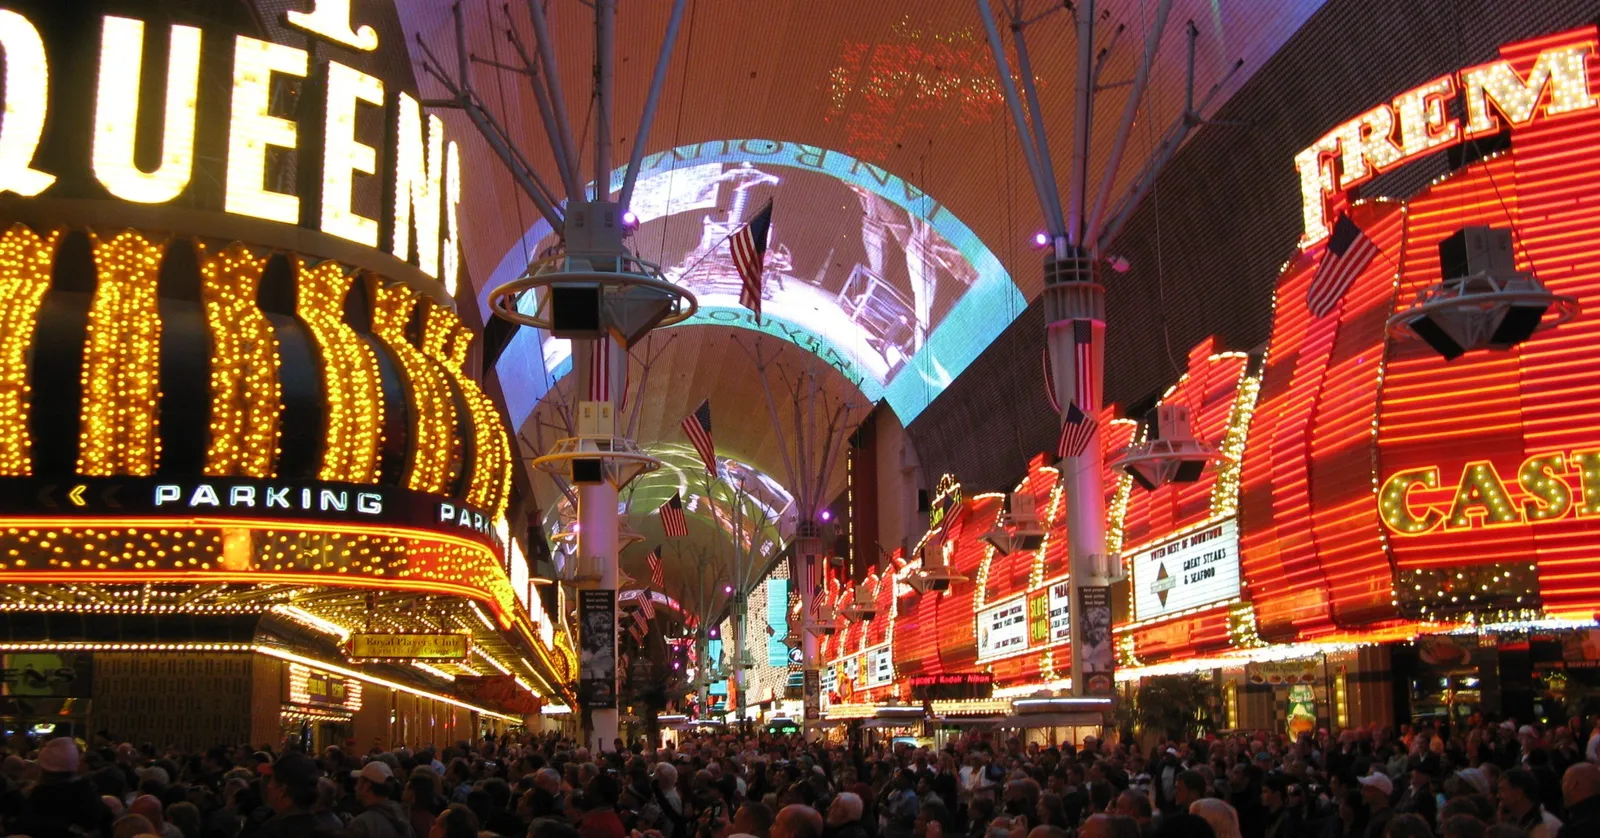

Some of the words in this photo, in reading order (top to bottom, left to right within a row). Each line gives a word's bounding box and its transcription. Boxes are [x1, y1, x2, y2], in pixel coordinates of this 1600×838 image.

[1294, 41, 1600, 250] FREM
[154, 484, 383, 514] PARKING
[441, 503, 499, 548] PARK
[1167, 542, 1180, 555] BEST
[1182, 538, 1188, 549] OF
[1191, 526, 1222, 547] DOWNTOWN
[1183, 556, 1201, 571] GREAT
[1203, 548, 1226, 565] STEAKS
[1184, 574, 1188, 585] &
[1190, 567, 1215, 584] SEAFOOD
[366, 637, 394, 647] Royal
[397, 637, 433, 647] Players
[434, 637, 459, 646] Club
[940, 675, 962, 683] Kodak
[967, 674, 990, 682] Nikon
